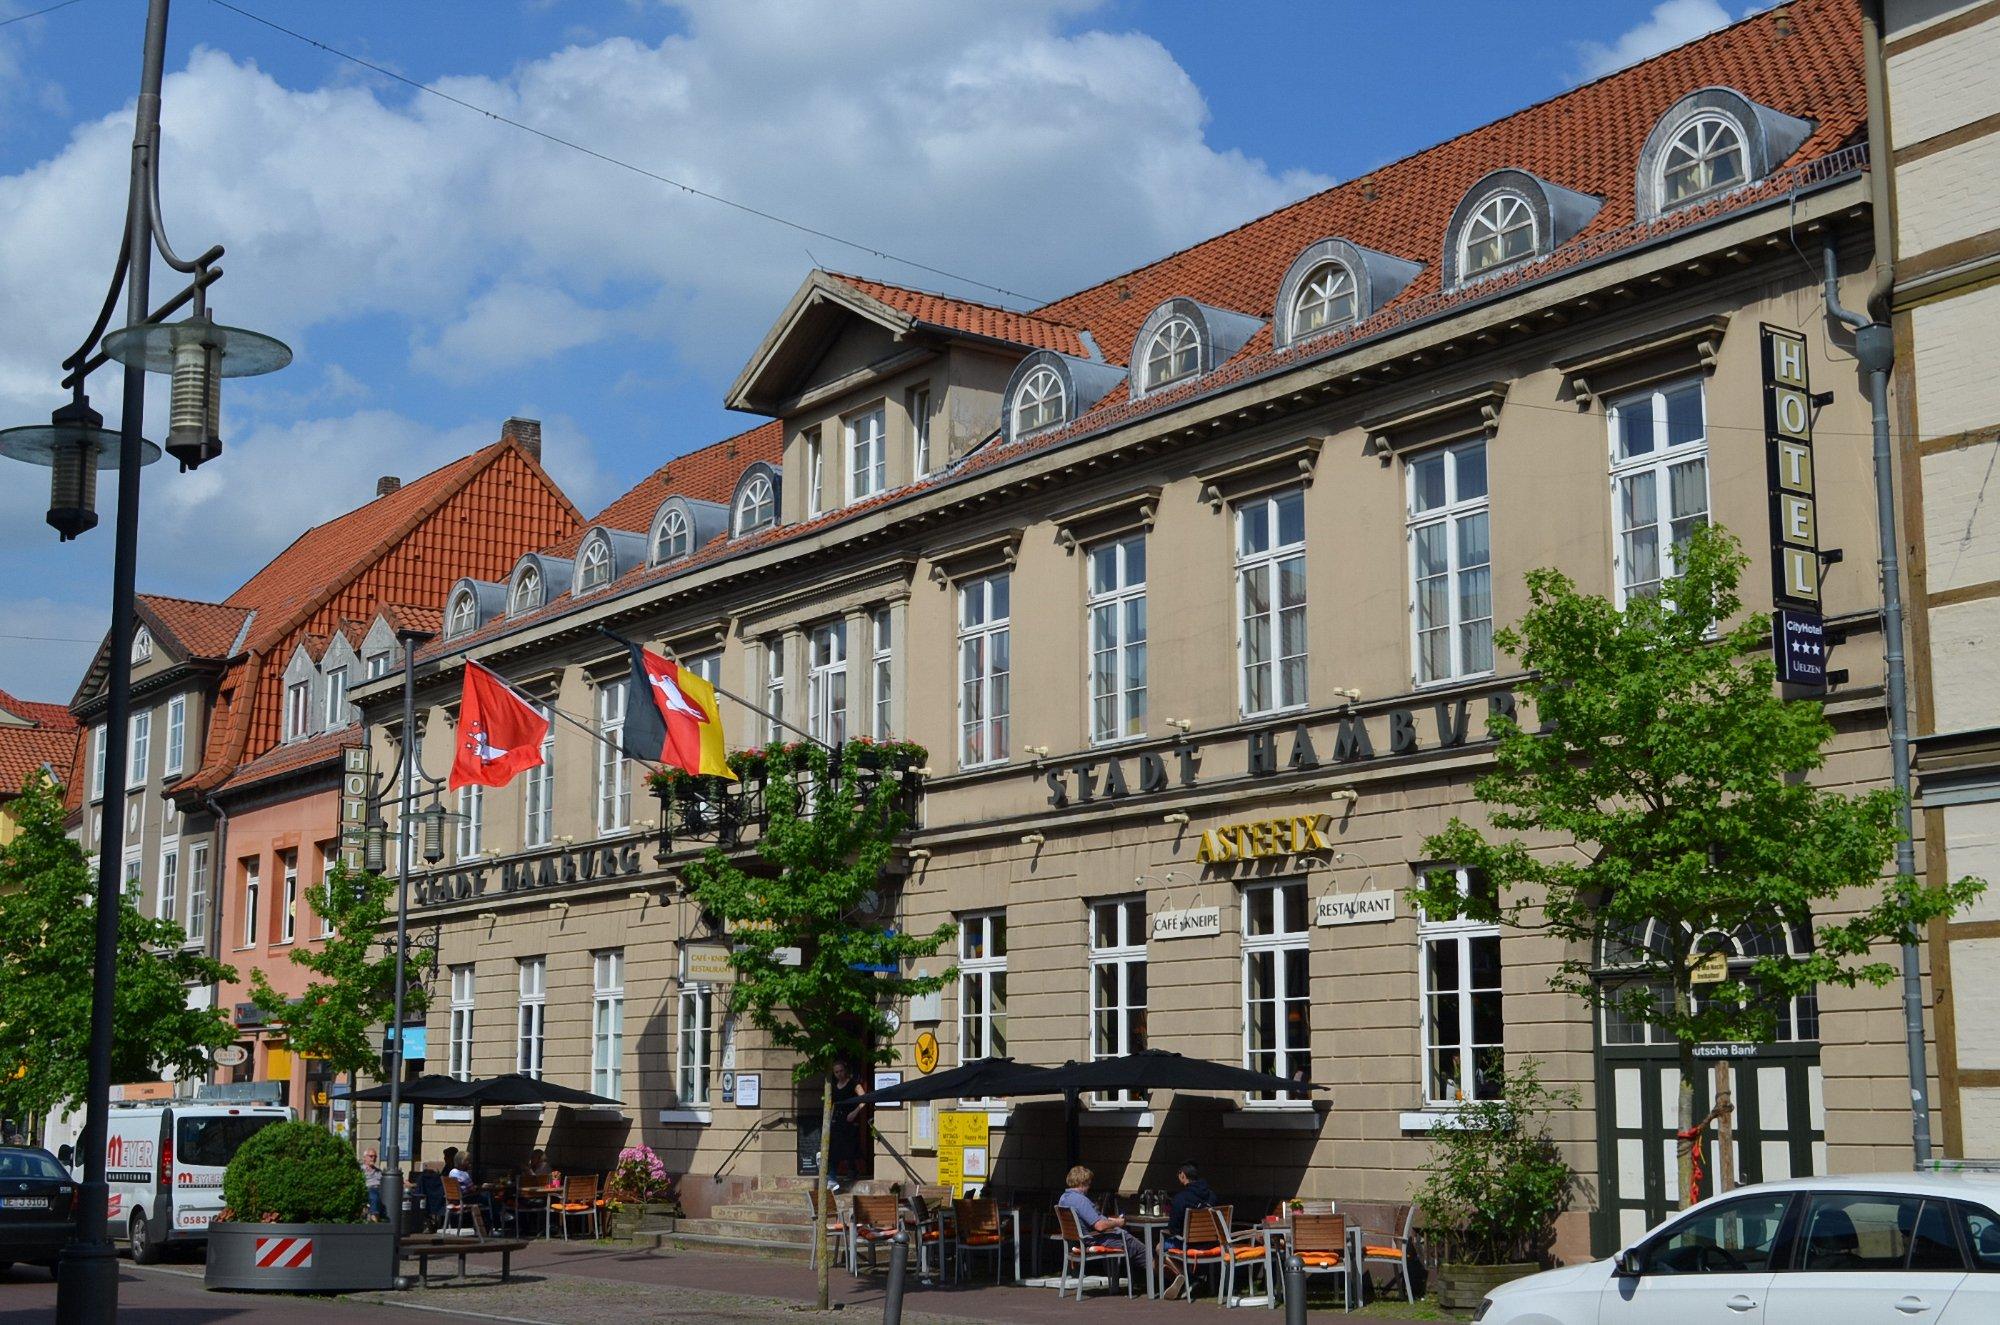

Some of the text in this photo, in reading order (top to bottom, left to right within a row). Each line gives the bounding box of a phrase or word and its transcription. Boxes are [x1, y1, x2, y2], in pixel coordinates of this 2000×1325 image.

[1780, 341, 1813, 594] HOTEL
[1787, 621, 1822, 635] CityHotel
[1047, 686, 1558, 809] STADT HAMBUR
[347, 751, 365, 870] HOTEL
[413, 842, 641, 906] STADT HAMBURG
[1319, 897, 1391, 917] RESTAURANT
[1154, 914, 1218, 931] CAFÉ KNEIPE
[1692, 1045, 1757, 1056] utsche Bank
[107, 1134, 153, 1168] MEYER
[178, 1172, 222, 1184] MEYER
